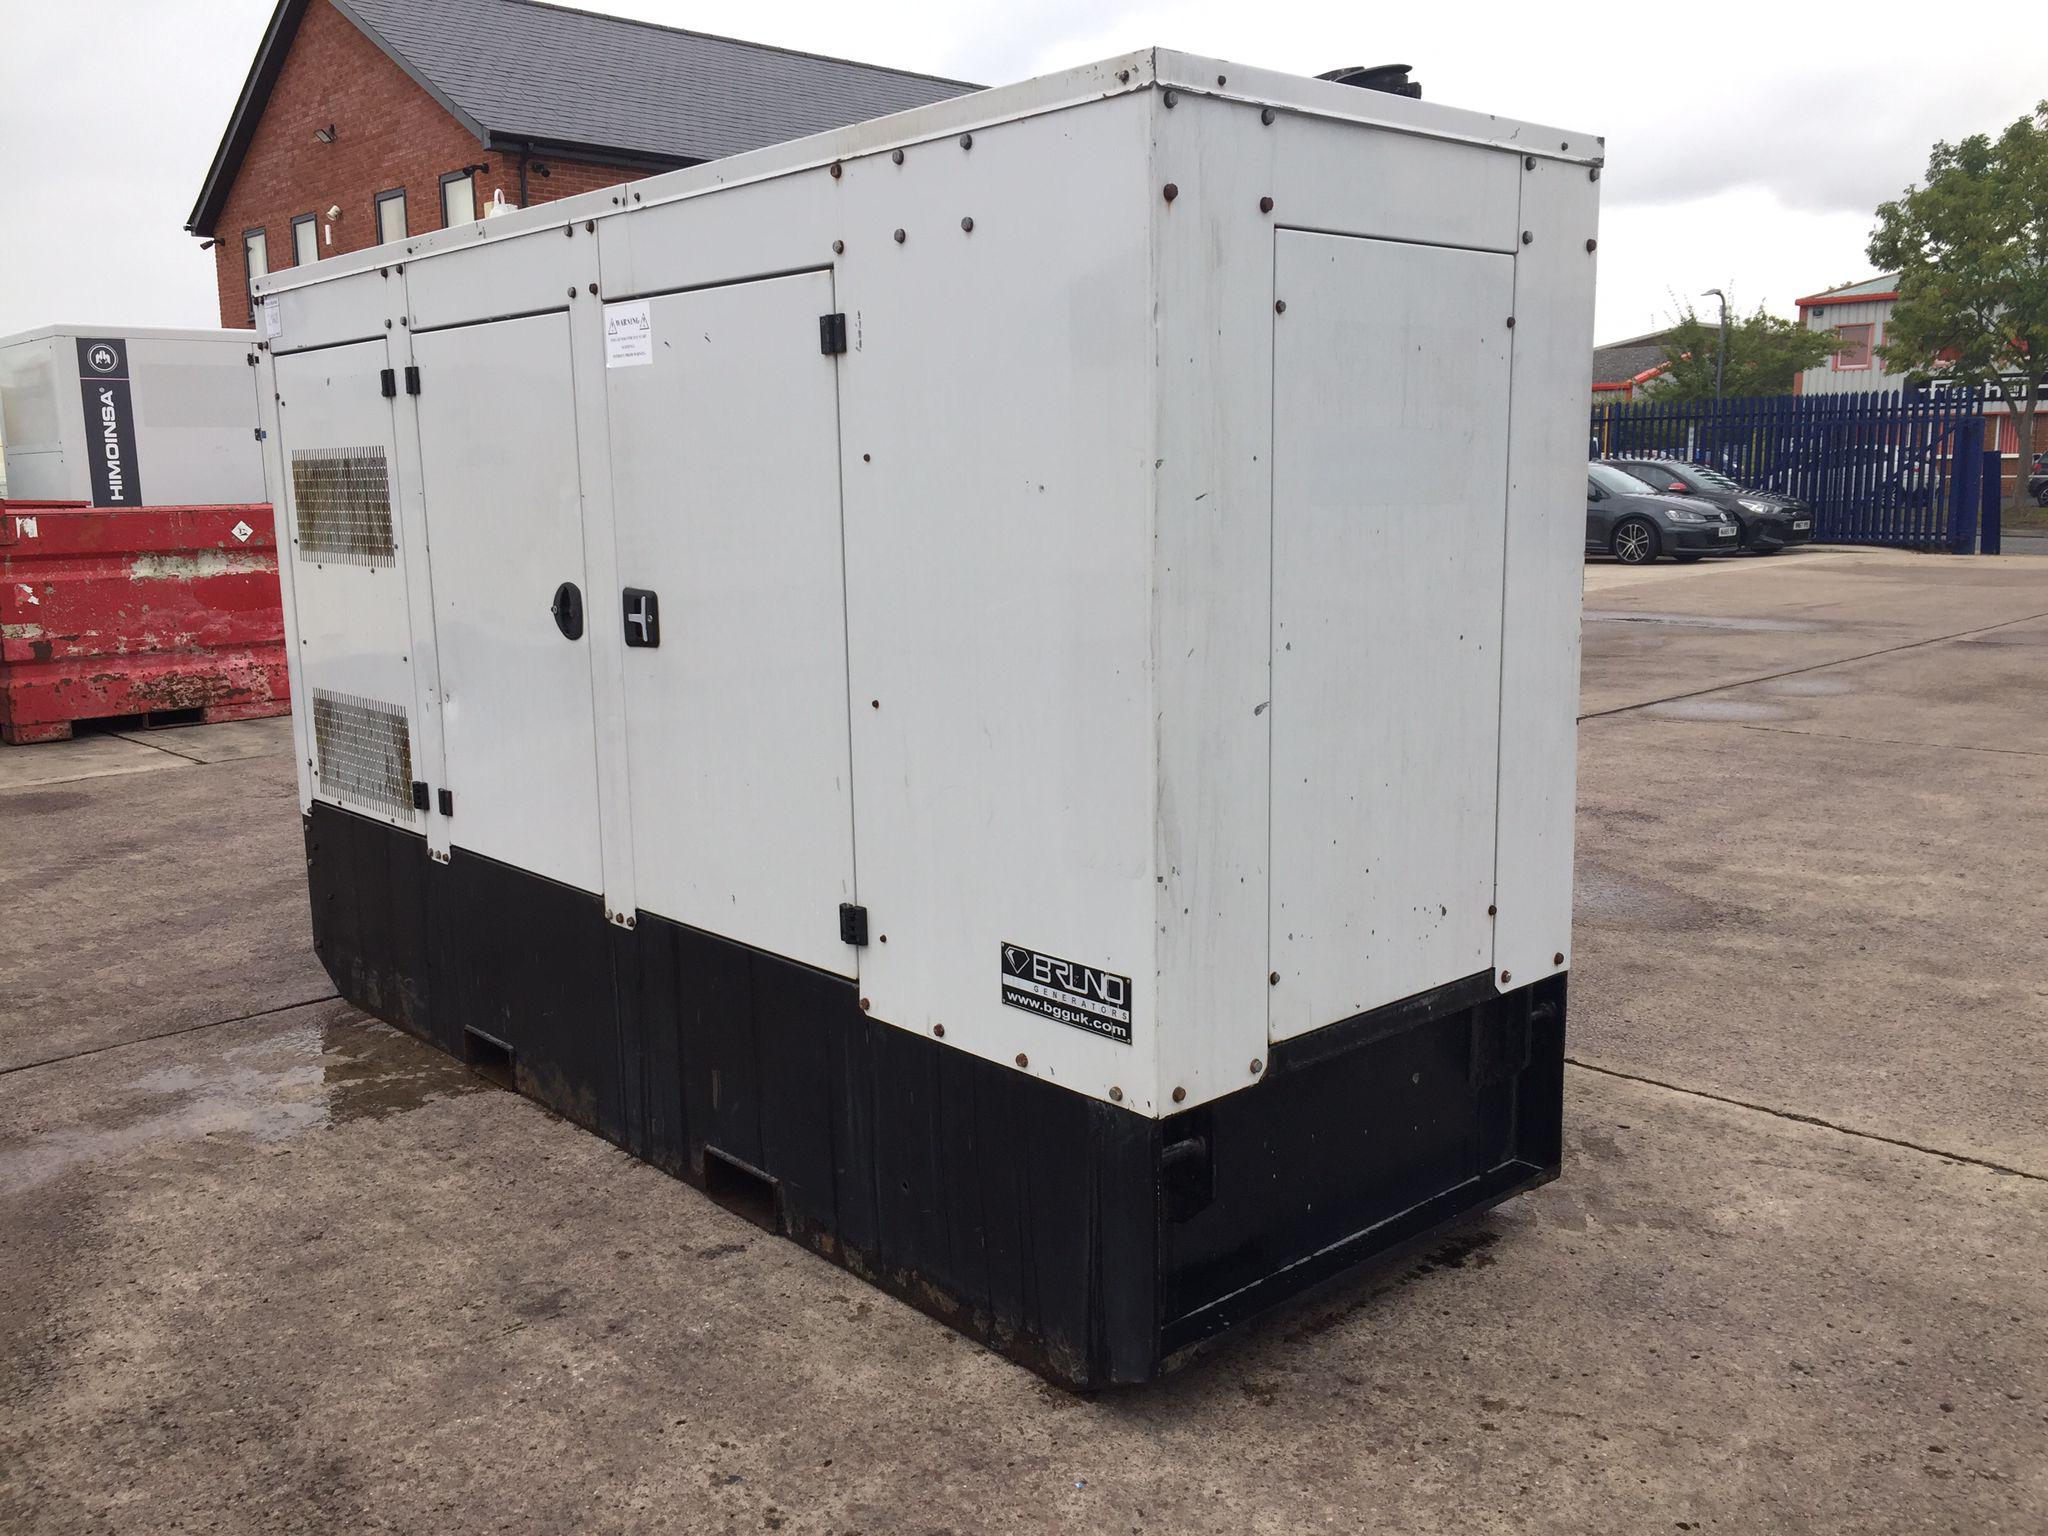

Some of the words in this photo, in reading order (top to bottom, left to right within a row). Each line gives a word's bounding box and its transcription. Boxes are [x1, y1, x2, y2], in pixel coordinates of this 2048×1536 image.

[615, 316, 640, 327] WARNING
[100, 389, 124, 500] HIMOINSA
[1033, 953, 1124, 1005] BRUNO
[1006, 991, 1127, 1037] www.bgguk.com
[1033, 985, 1128, 1020] GENERATORS
